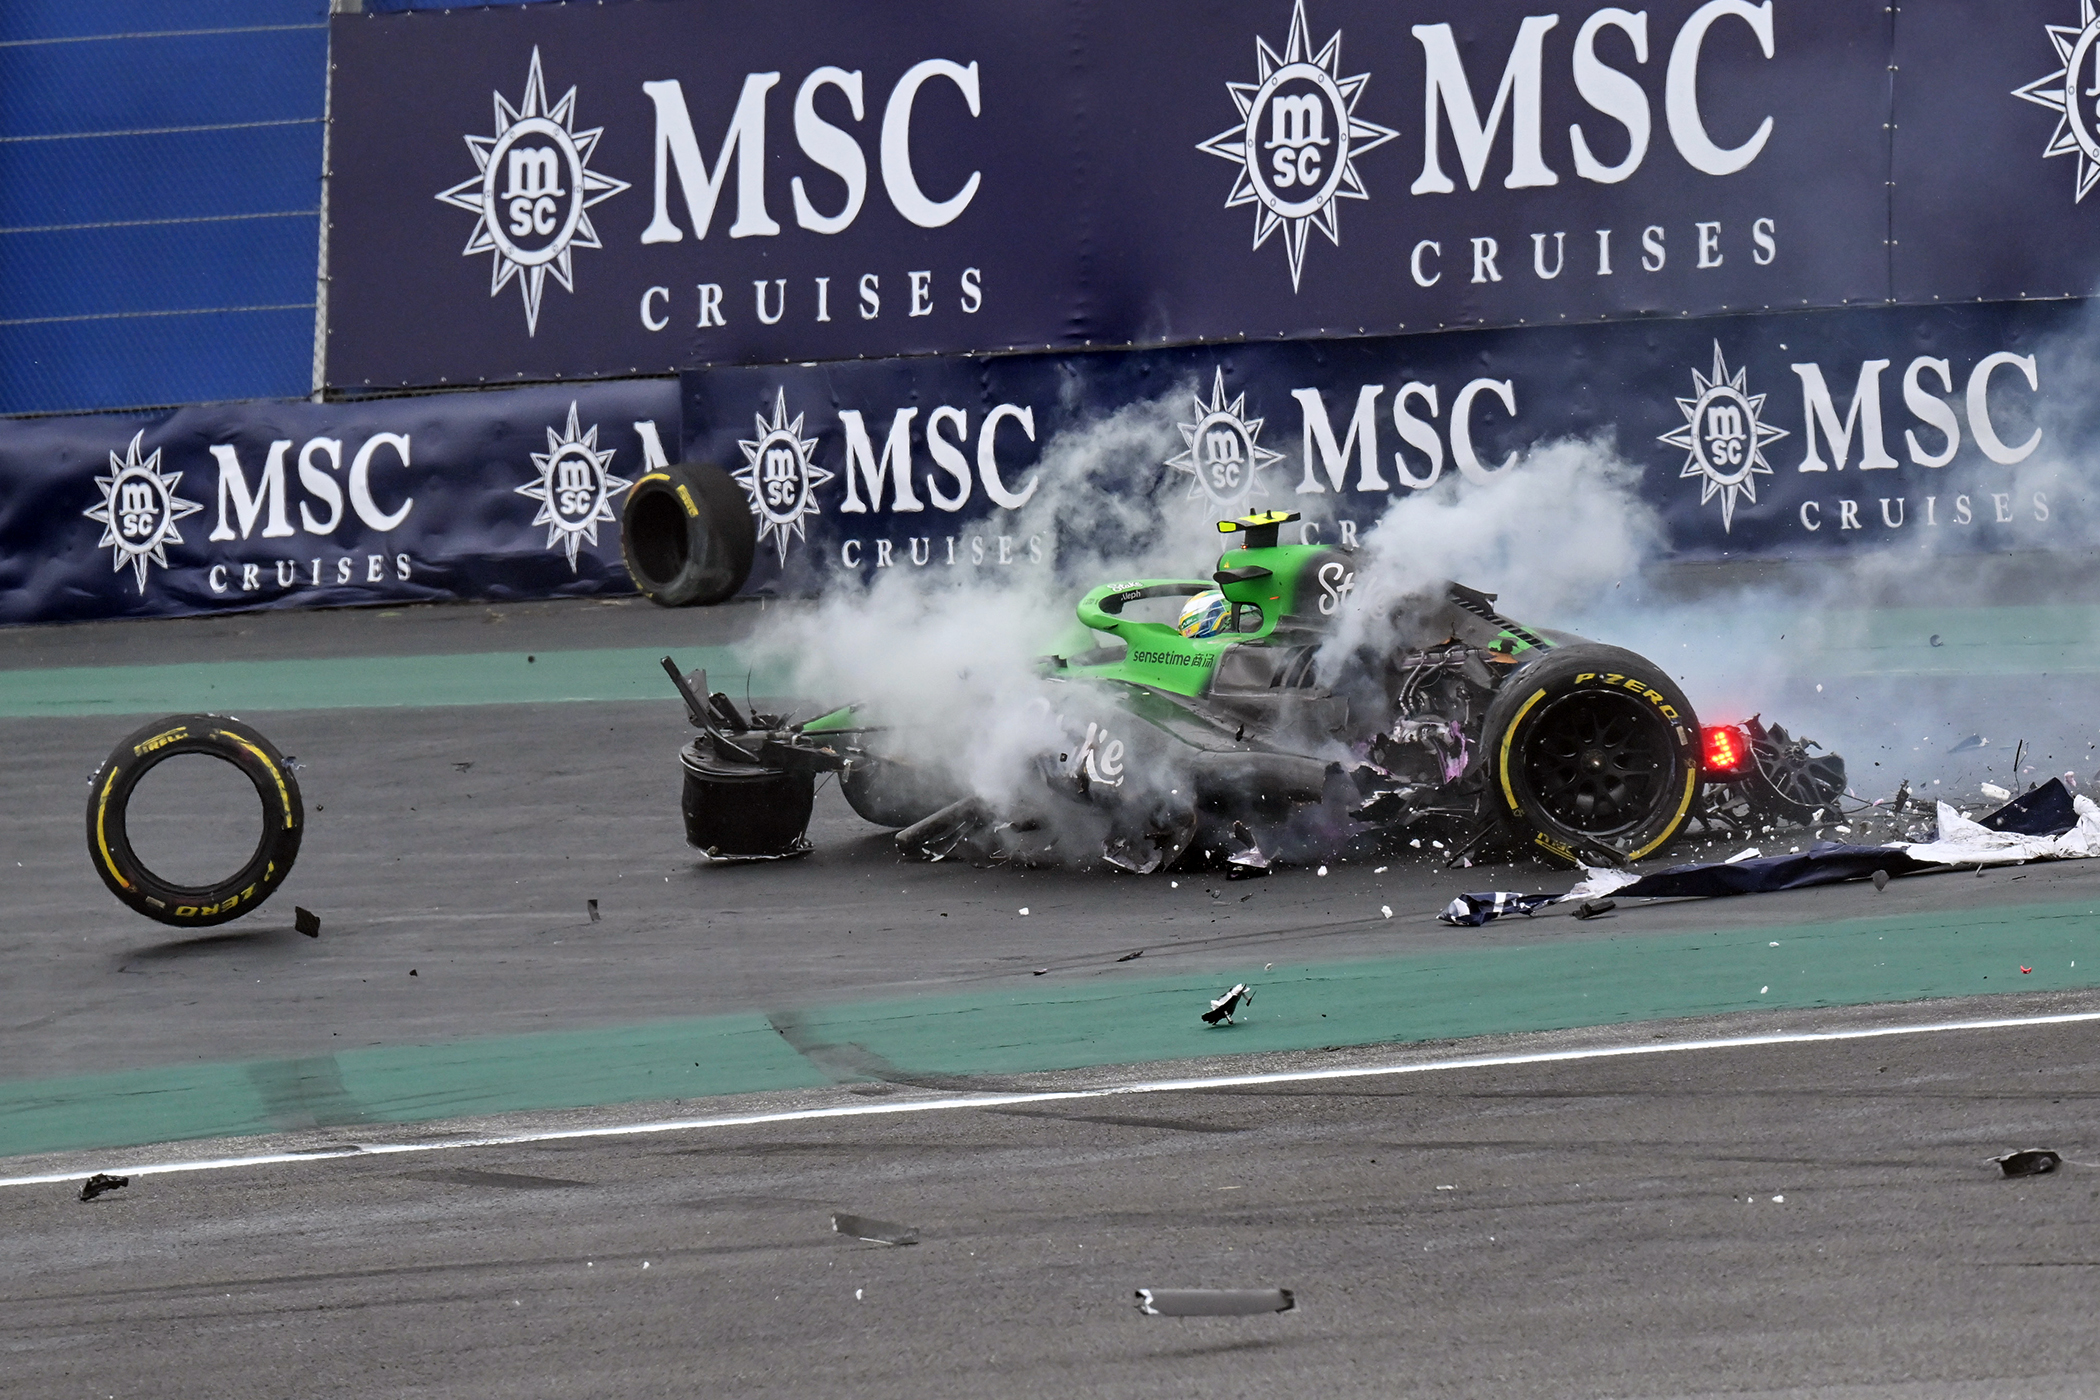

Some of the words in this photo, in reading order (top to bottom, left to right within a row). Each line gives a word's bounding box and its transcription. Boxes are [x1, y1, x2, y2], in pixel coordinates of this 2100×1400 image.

[1411, 0, 1775, 196] MSC
[641, 59, 981, 244] MSC
[1411, 217, 1776, 287] CRUISES
[640, 268, 982, 331] CRUISES
[1291, 378, 1517, 493] MSC
[1791, 351, 2043, 472] MSC
[209, 432, 413, 541] MSC
[838, 403, 1039, 515] MSC
[1801, 491, 2050, 532] CRUISES
[209, 553, 411, 594] CRUISES
[841, 535, 1044, 569] CRUISES
[1132, 650, 1191, 666] sensetime
[1574, 672, 1596, 685] P
[1604, 672, 1680, 720] ZERO
